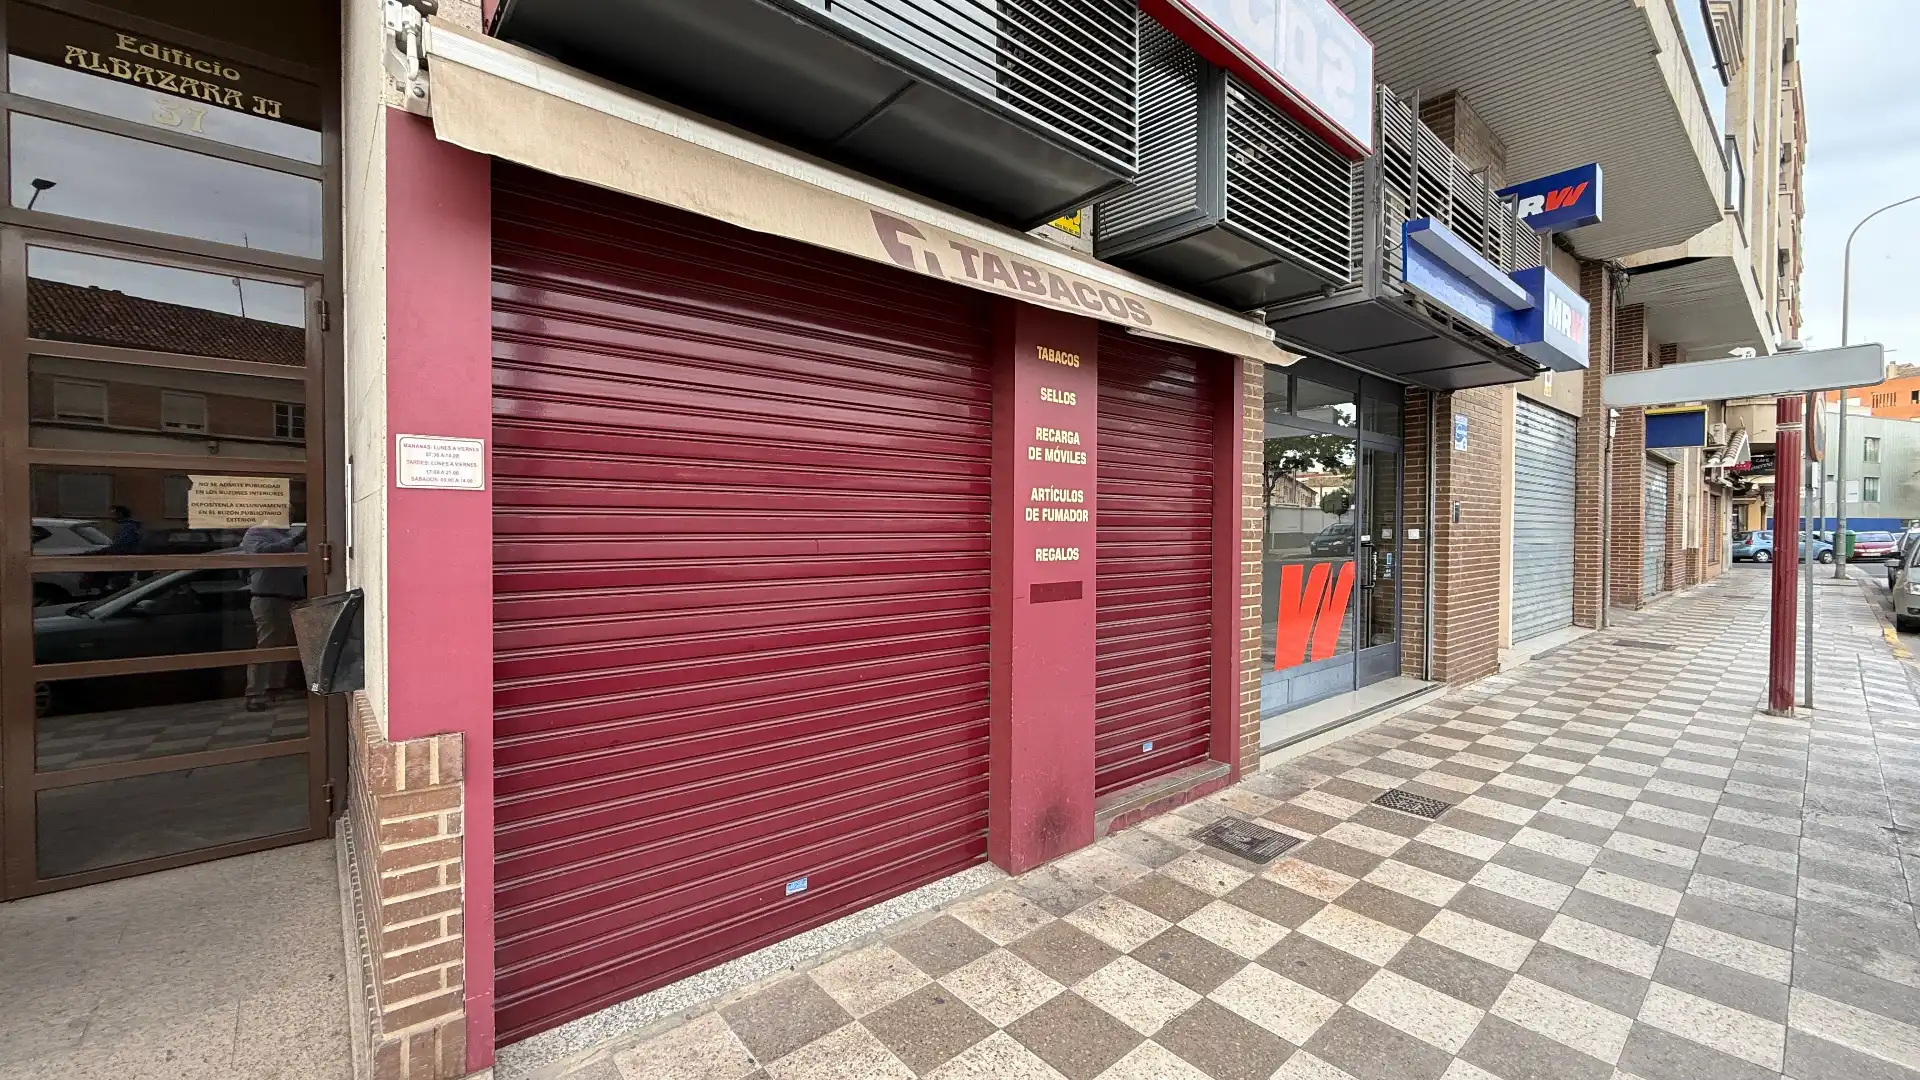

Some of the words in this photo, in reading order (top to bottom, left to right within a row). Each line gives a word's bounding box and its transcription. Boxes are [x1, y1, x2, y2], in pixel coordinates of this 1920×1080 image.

[115, 32, 241, 81] Edificio
[64, 44, 243, 108] ALBAZARA
[1504, 182, 1588, 220] RW
[948, 239, 1153, 327] TABACOS
[1547, 291, 1586, 344] MRW
[1036, 346, 1080, 368] TABACOS
[1040, 387, 1076, 406] SELLOS
[1036, 427, 1080, 445] RECARGA
[1028, 447, 1042, 461] DE
[1045, 445, 1087, 465] MÓVILES
[1031, 485, 1084, 503] ARTÍCULOS
[1025, 507, 1039, 522] DE
[1042, 508, 1089, 522] FUMADOR
[1035, 547, 1079, 562] REGALOS
